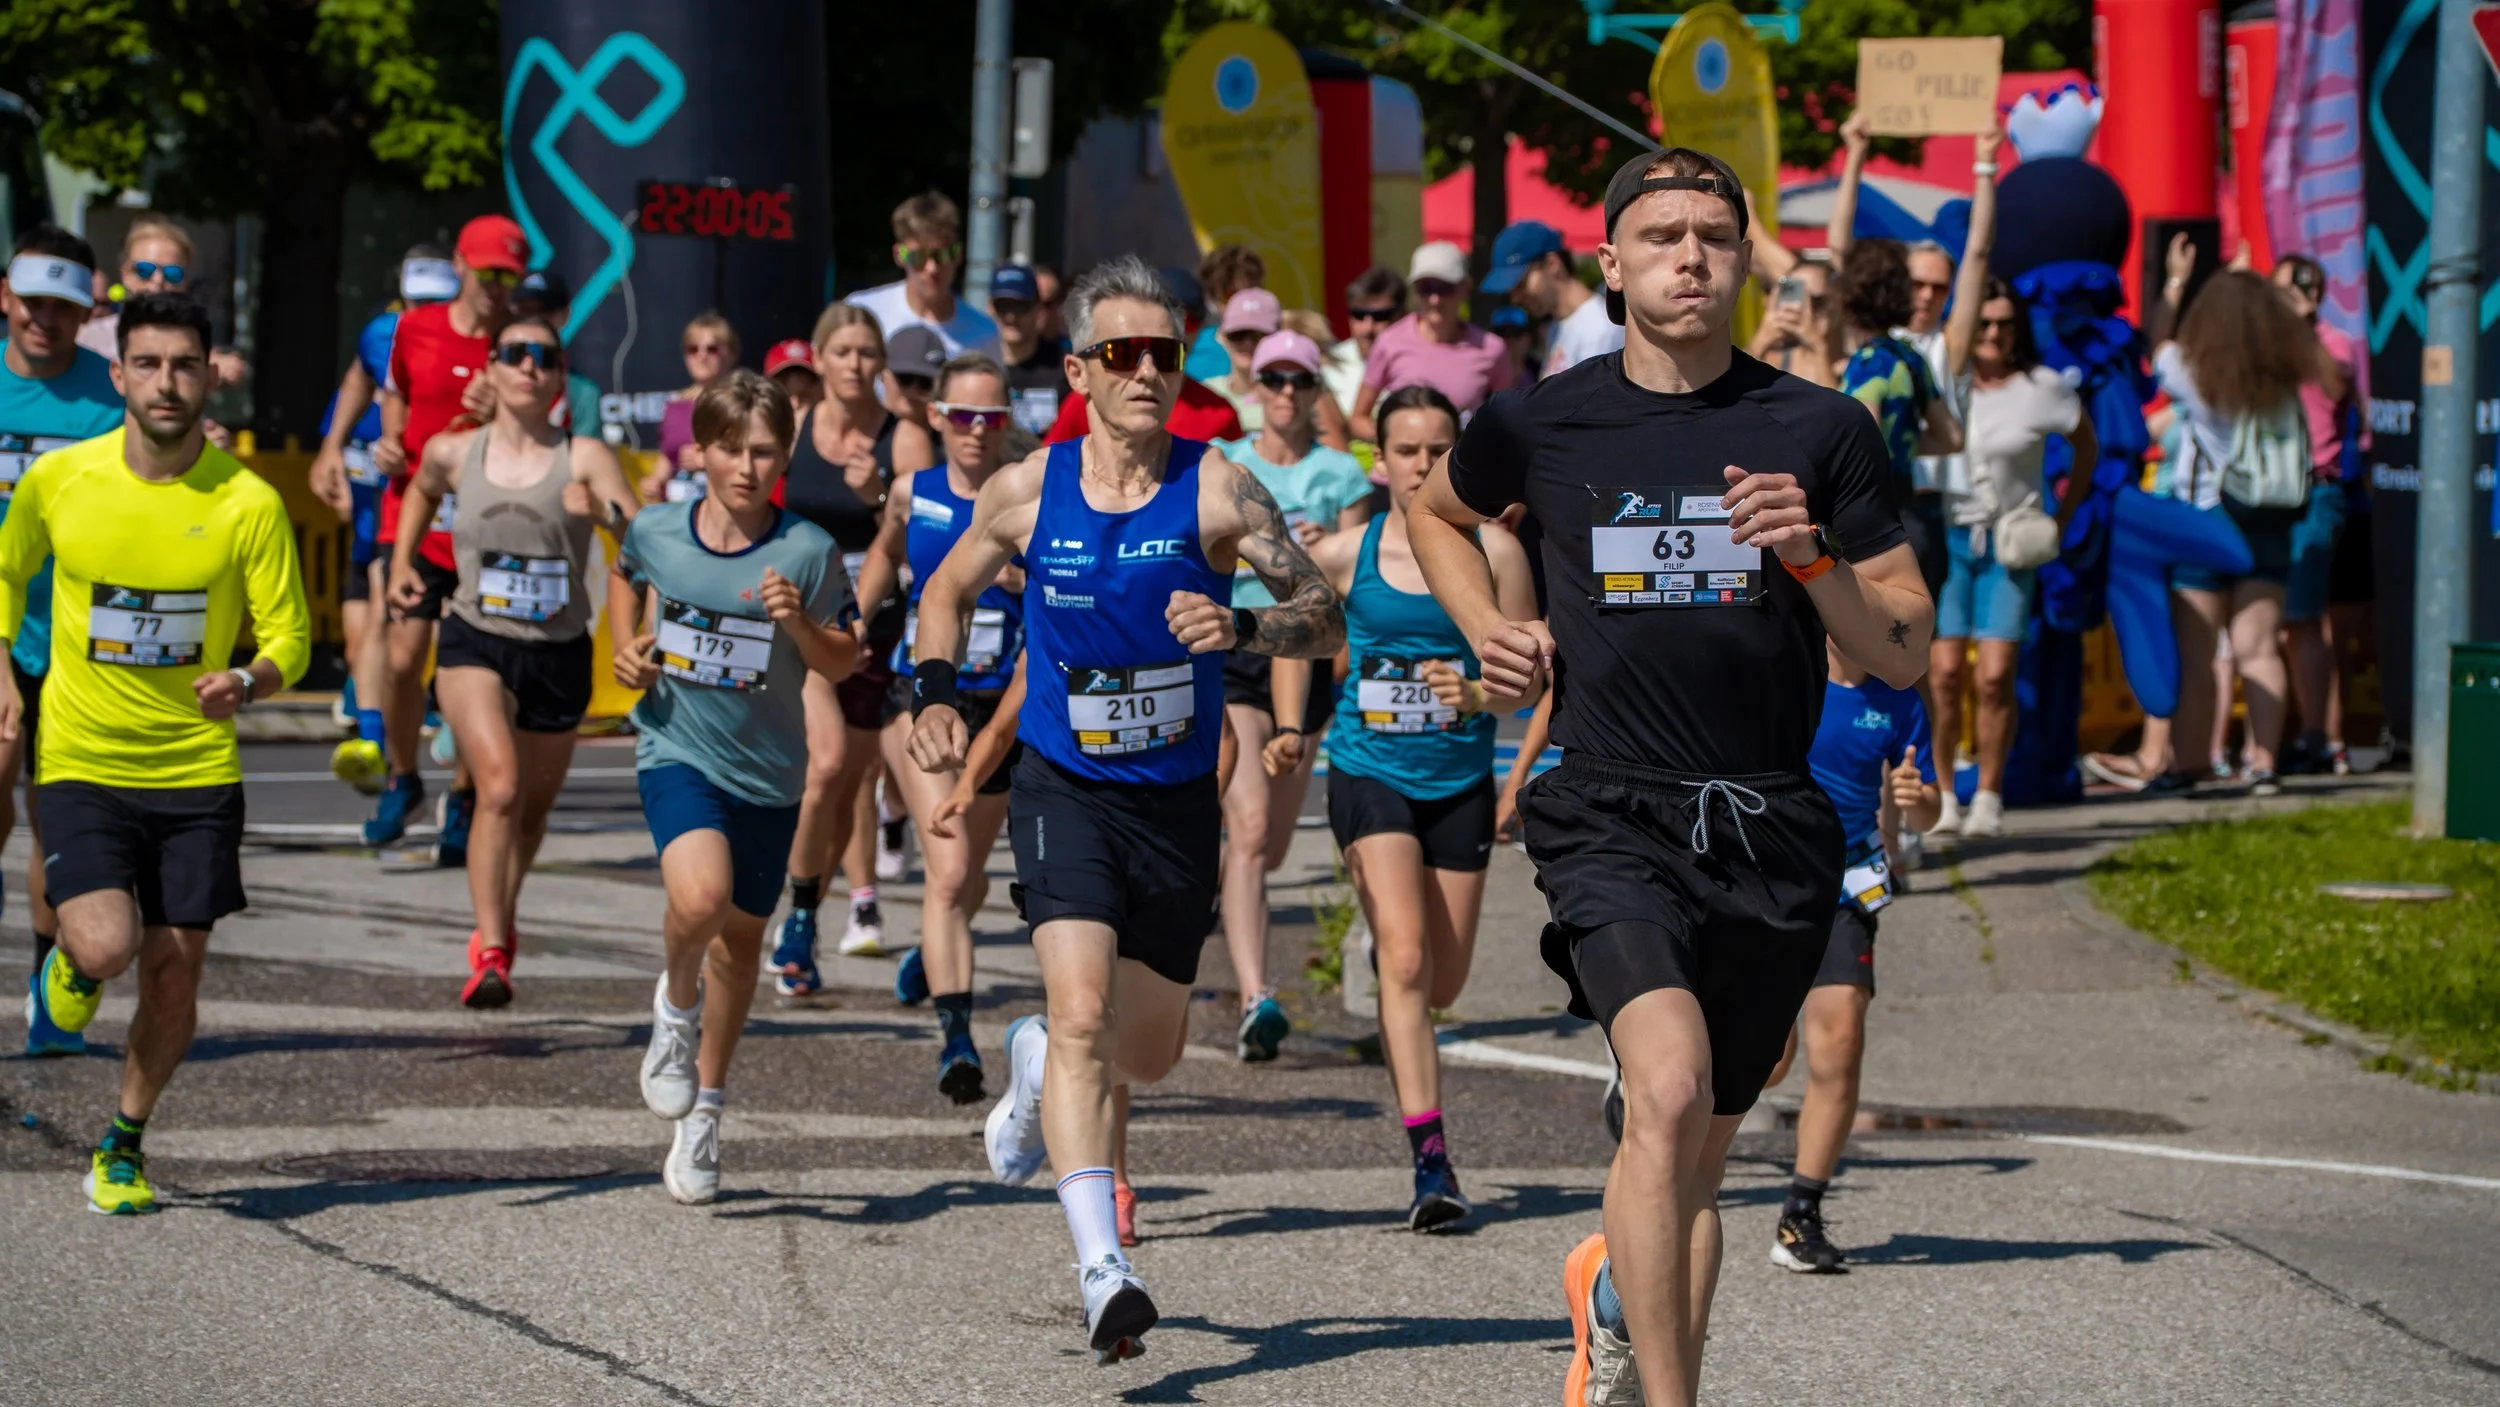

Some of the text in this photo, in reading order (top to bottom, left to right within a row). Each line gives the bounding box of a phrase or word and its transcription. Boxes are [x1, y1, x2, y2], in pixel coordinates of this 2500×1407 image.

[1638, 508, 1661, 516] RUN
[1652, 530, 1695, 561] 63
[1048, 568, 1078, 578] THOMAS
[1663, 562, 1685, 571] FILIP
[1056, 593, 1095, 602] BUSINESS
[133, 617, 162, 635] 77
[693, 634, 735, 658] 179
[1391, 685, 1432, 704] 220
[1106, 696, 1156, 721] 210
